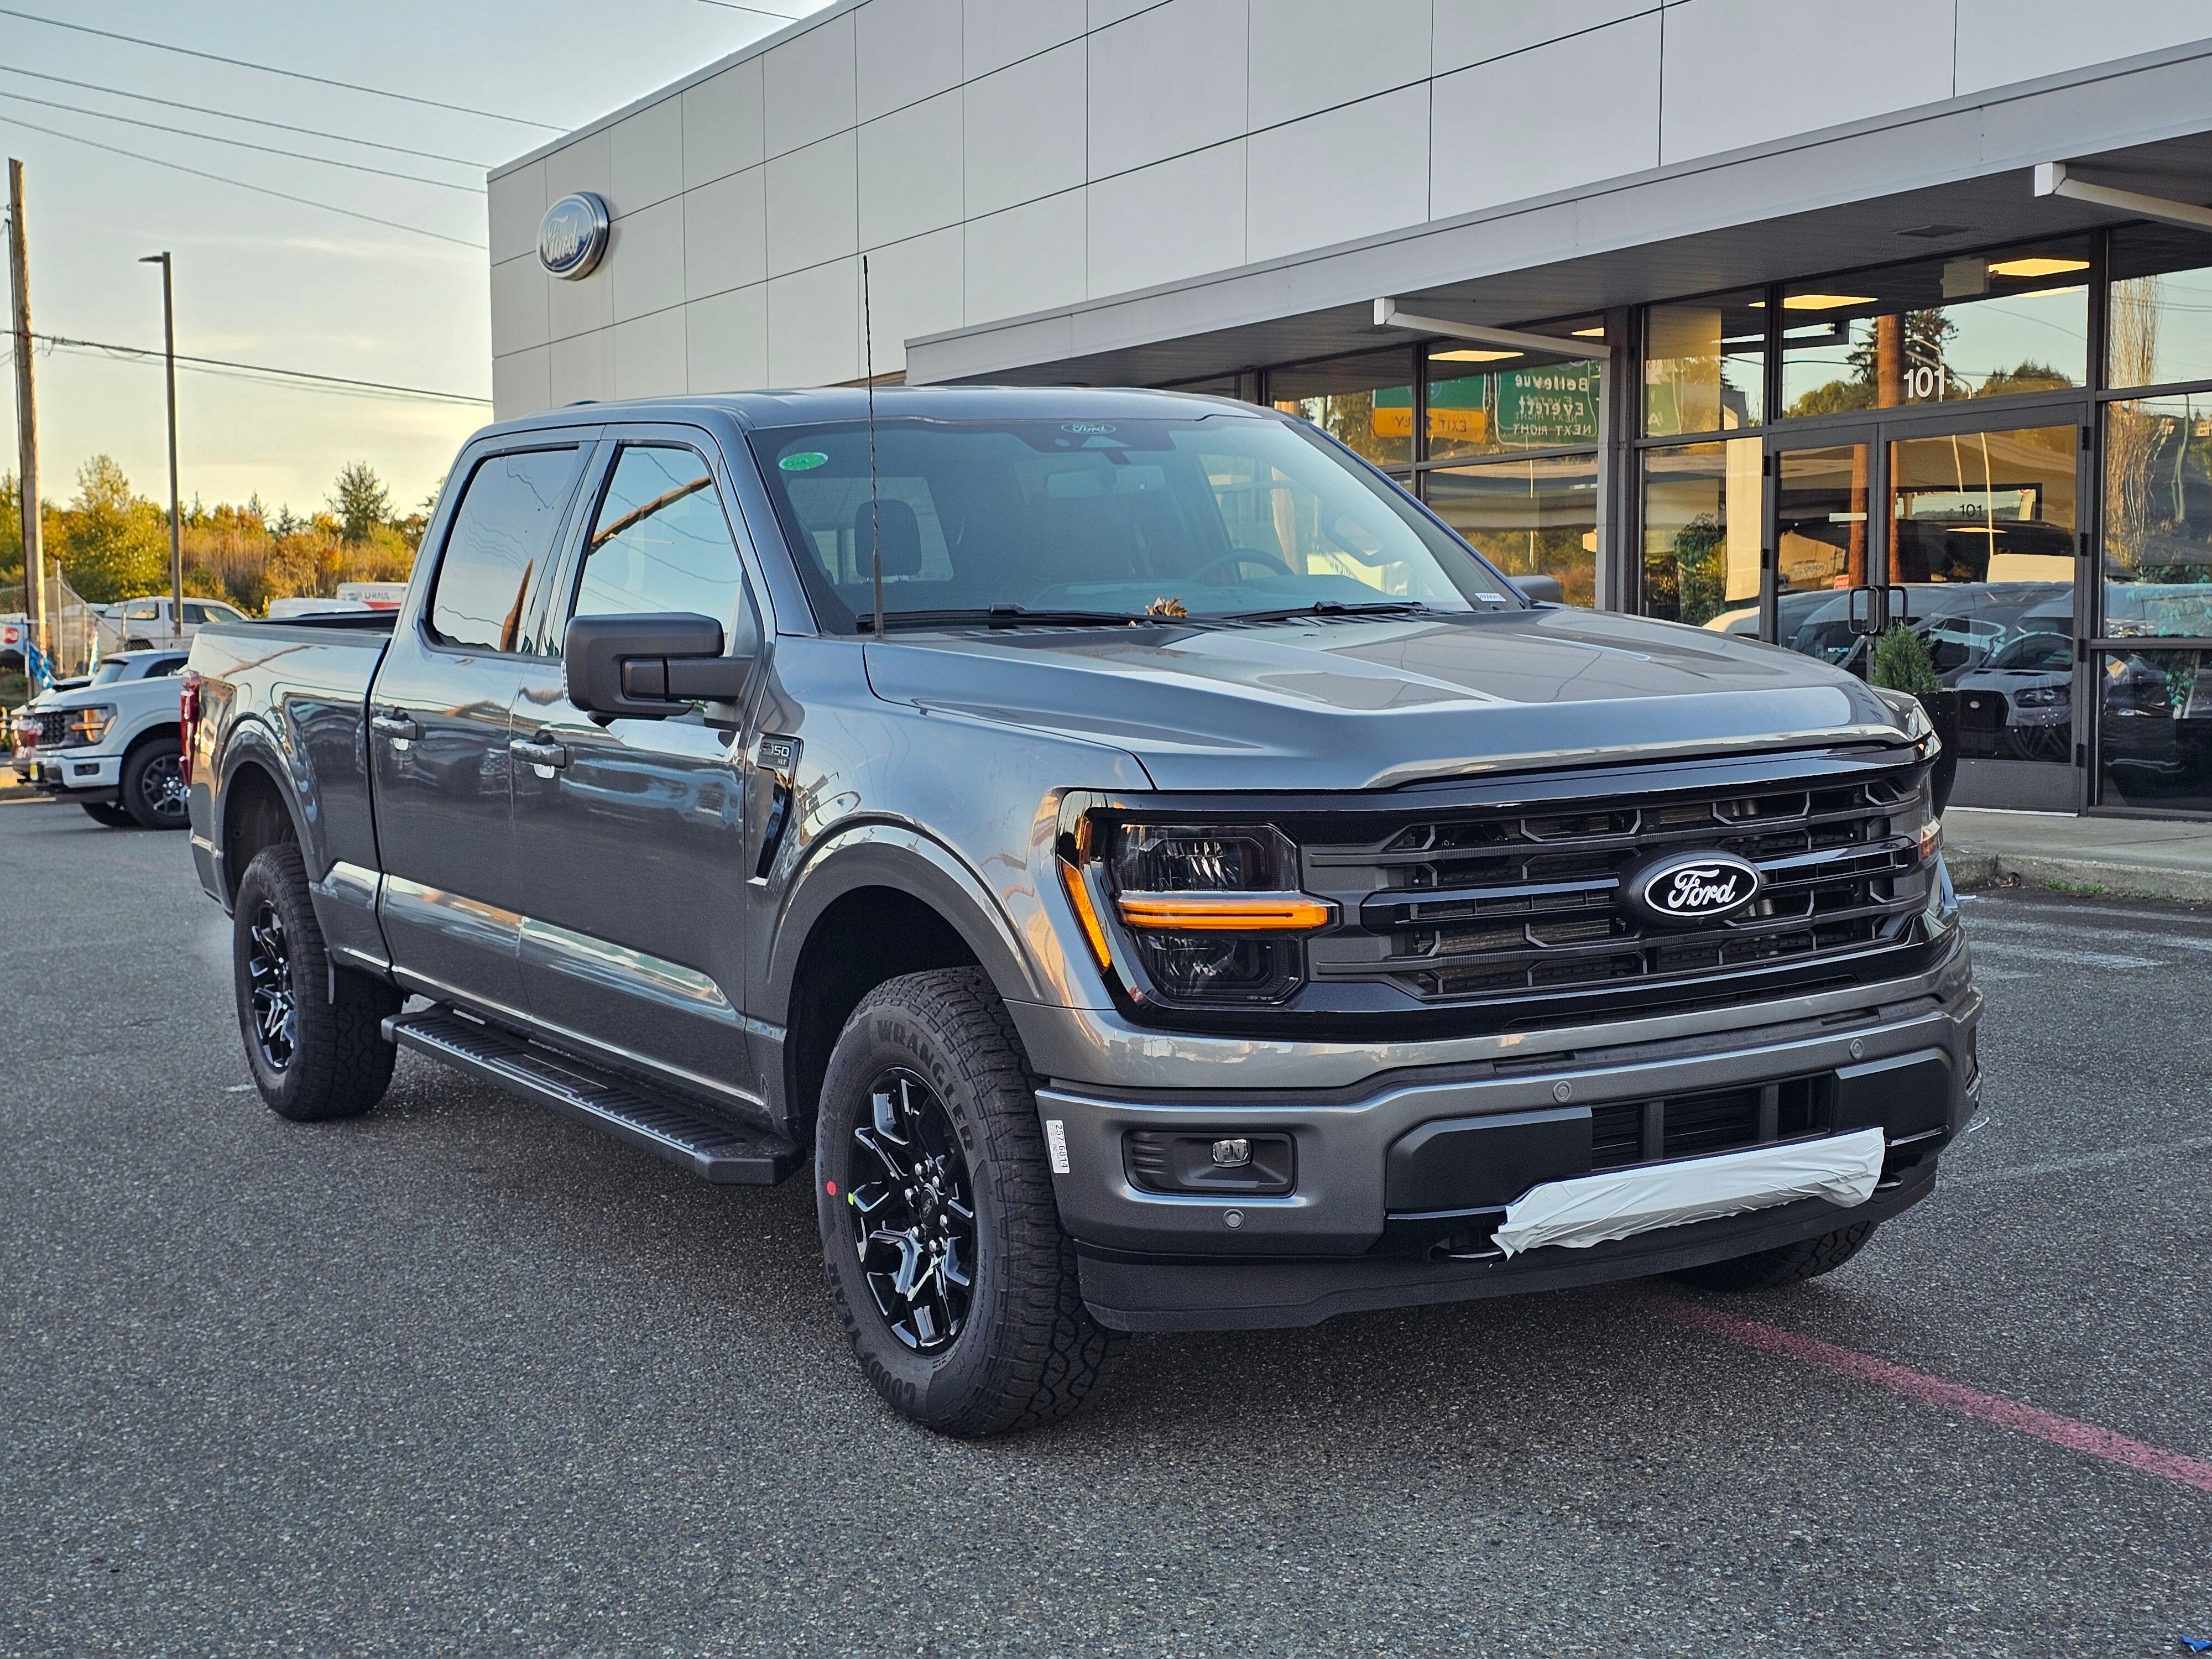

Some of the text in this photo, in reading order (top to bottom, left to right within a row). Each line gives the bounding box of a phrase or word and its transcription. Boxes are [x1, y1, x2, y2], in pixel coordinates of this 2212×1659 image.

[542, 214, 578, 263] Ford
[1903, 365, 1945, 398] 101
[1072, 424, 1107, 432] Ford
[1959, 504, 1982, 517] 101
[1667, 869, 1737, 909] Ford
[877, 1020, 975, 1152] WRANGLER
[827, 1262, 916, 1406] GOODYEAR
